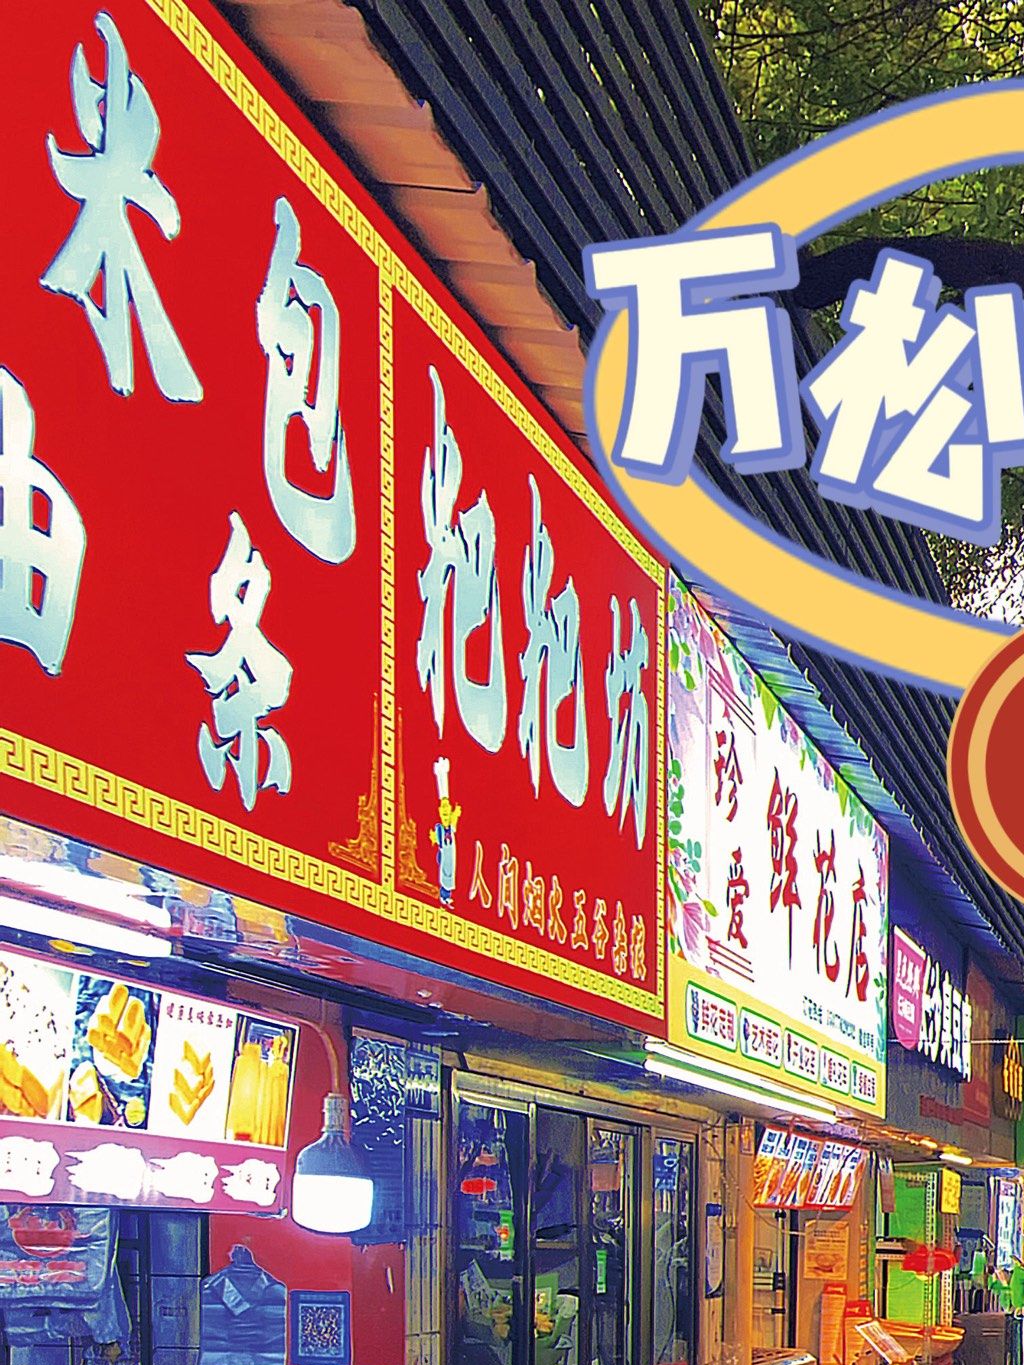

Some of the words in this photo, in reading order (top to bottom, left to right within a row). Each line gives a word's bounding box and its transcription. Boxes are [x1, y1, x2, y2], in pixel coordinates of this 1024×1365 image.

[468, 840, 647, 980] 人间烟火五谷杂粮
[767, 765, 872, 1002] 鲜花店
